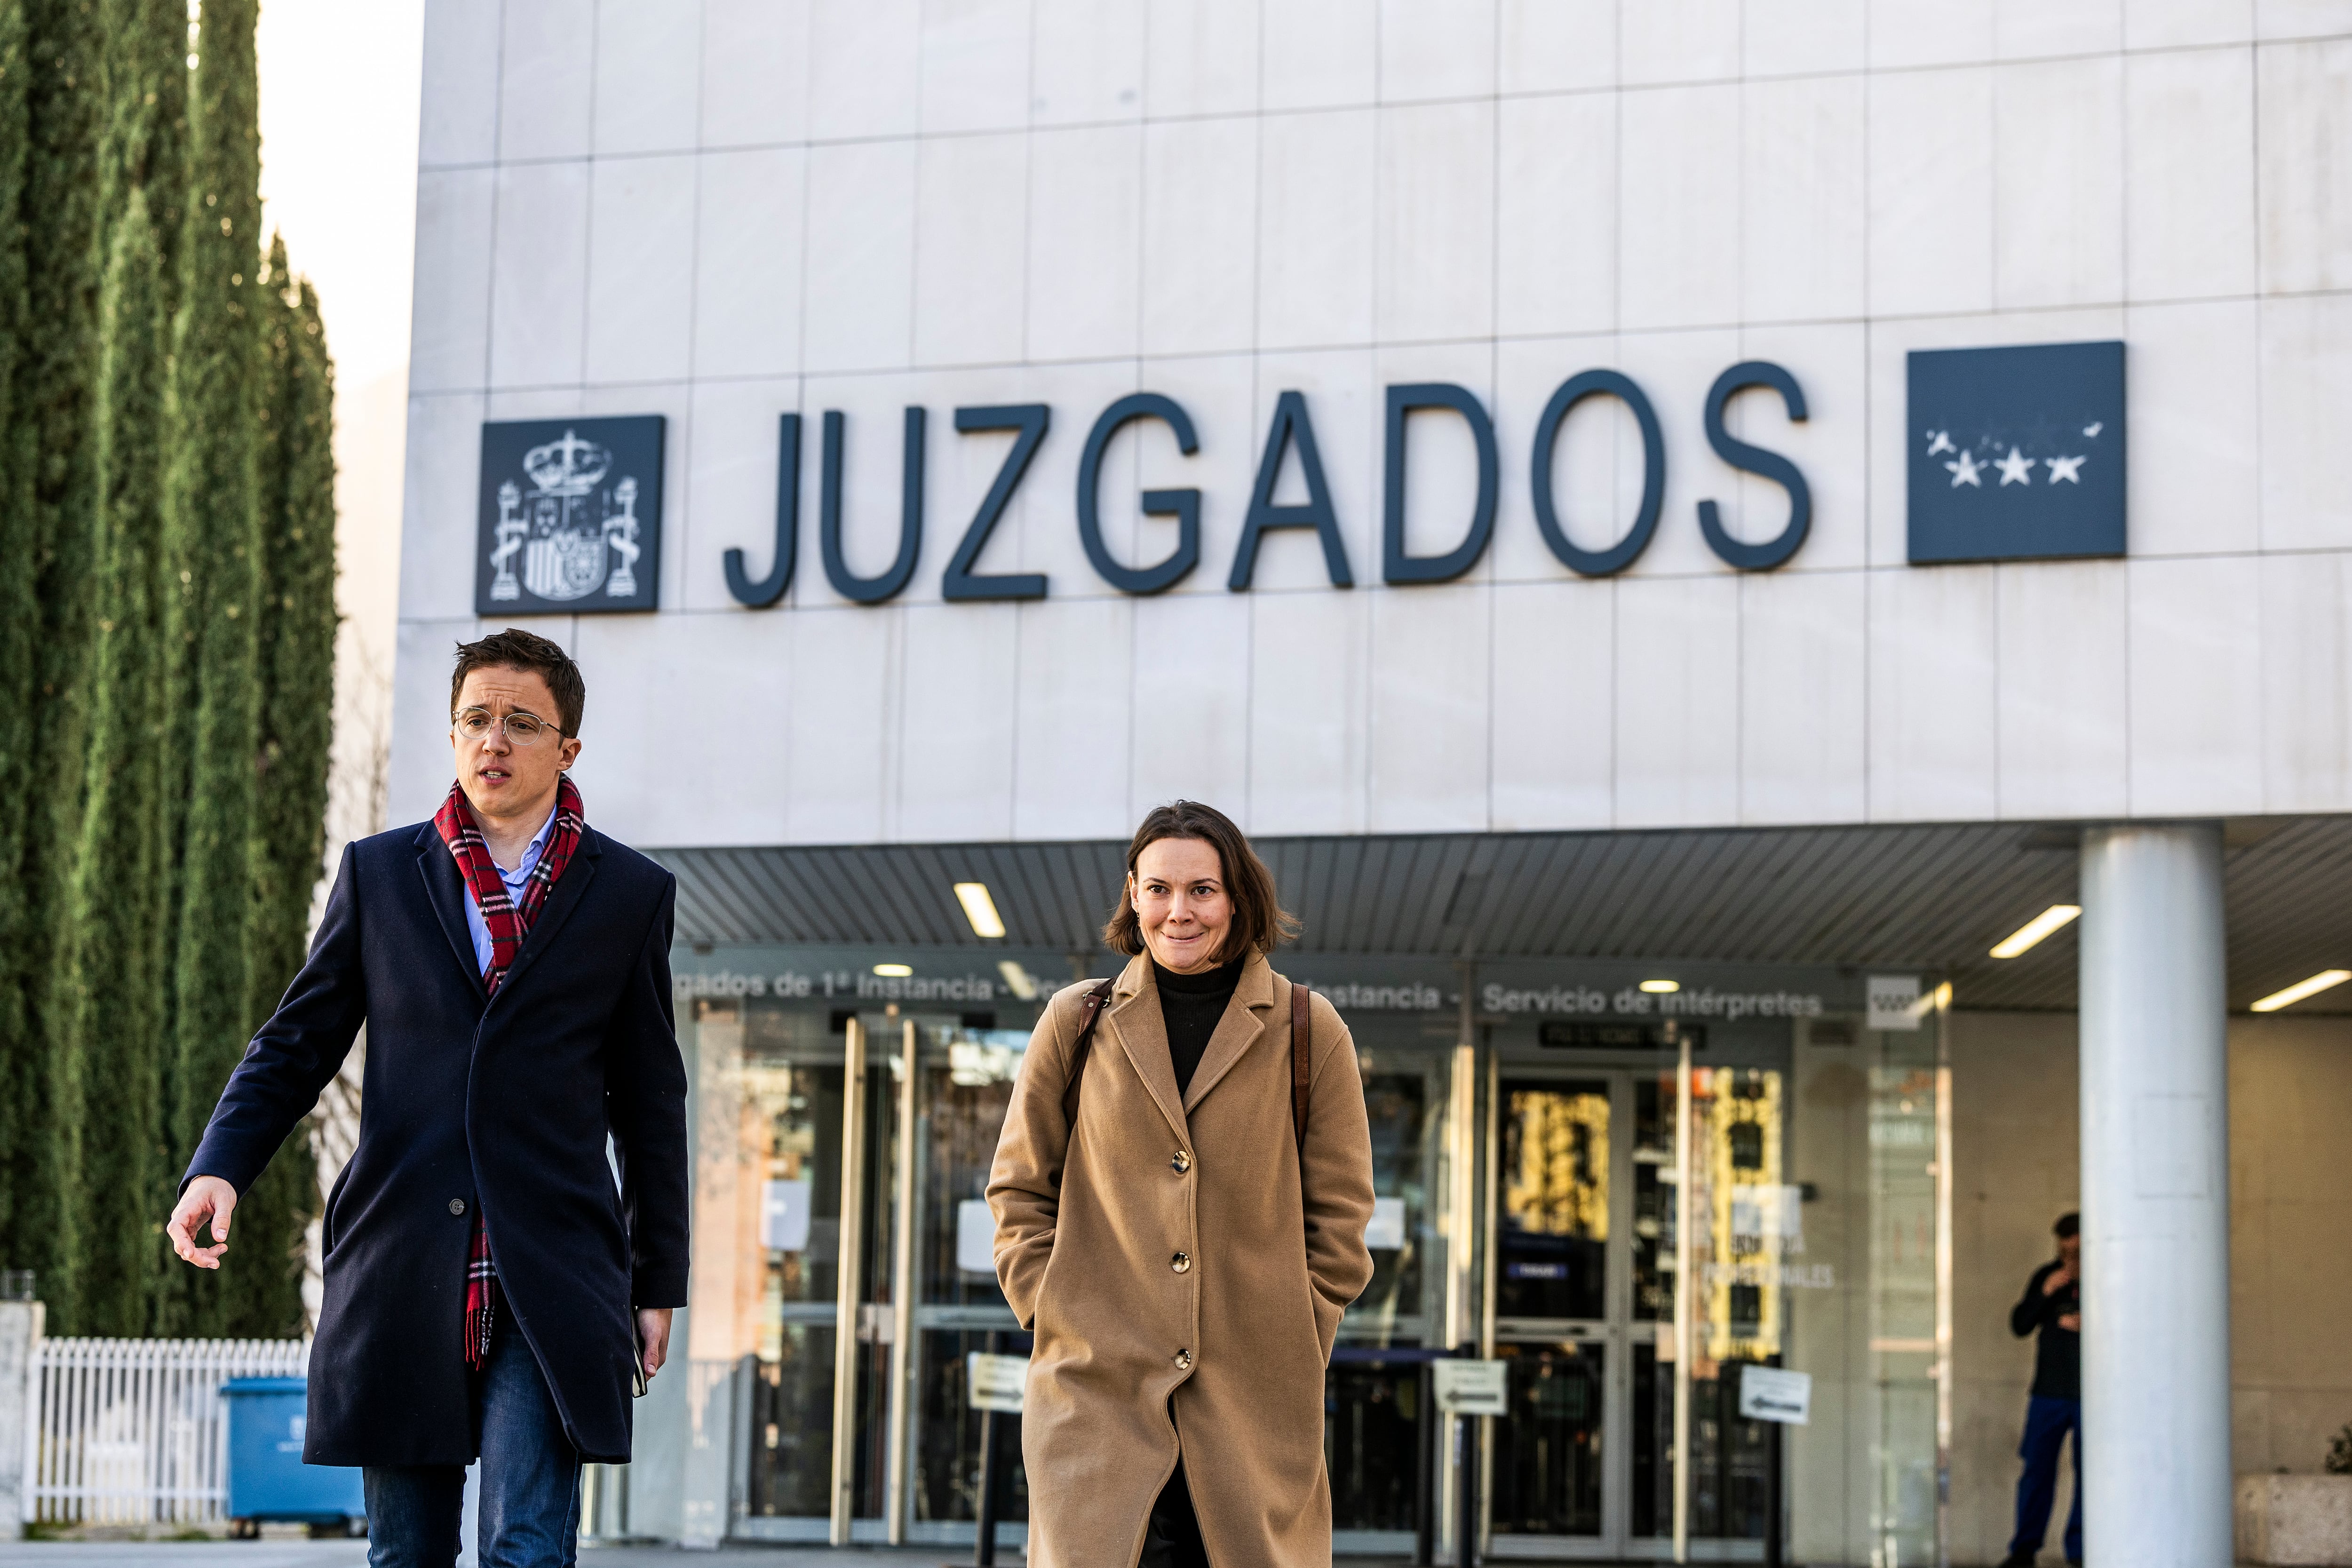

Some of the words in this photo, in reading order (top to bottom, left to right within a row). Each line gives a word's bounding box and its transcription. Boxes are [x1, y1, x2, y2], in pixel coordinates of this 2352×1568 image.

[723, 360, 1812, 608] JUZGADOS
[774, 970, 811, 998] de
[856, 972, 993, 1001] Instancia
[1304, 980, 1441, 1010] stancia
[1482, 981, 1607, 1014] Servicio
[1613, 986, 1651, 1015] de
[1658, 987, 1823, 1023] Intérpretes
